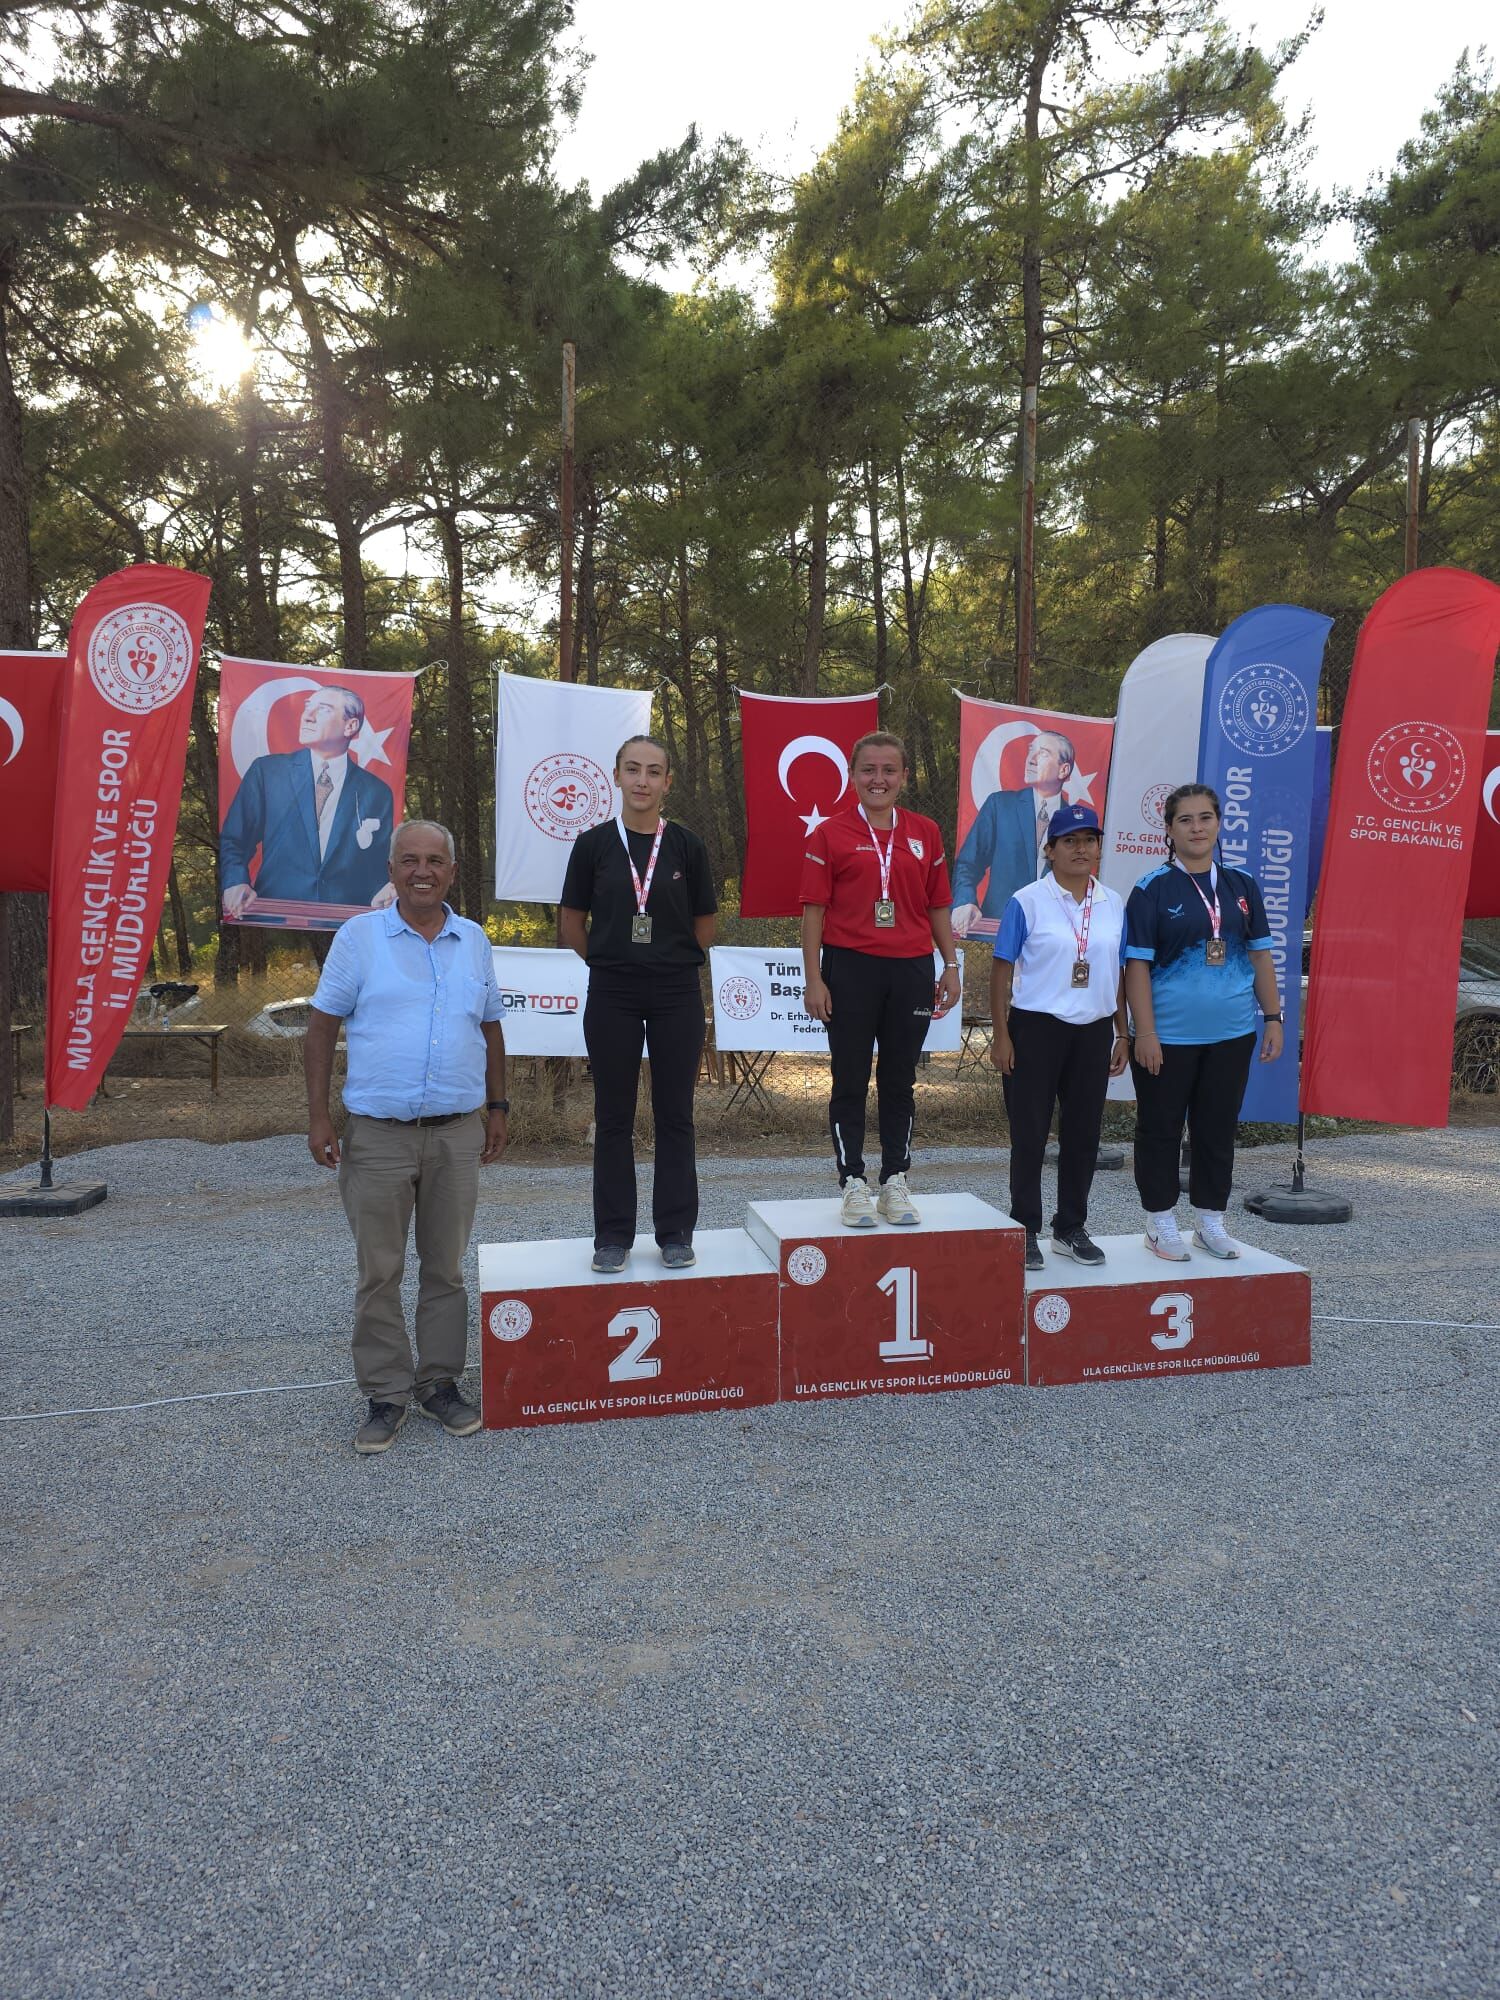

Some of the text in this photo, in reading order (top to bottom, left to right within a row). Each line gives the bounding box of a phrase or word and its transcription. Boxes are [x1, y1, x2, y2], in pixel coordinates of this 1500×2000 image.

[1223, 766, 1252, 832] SPOR
[1117, 831, 1136, 842] T.C.
[1355, 815, 1462, 836] T.C. GENÇLİK VE
[1115, 843, 1143, 854] SPOR
[1349, 828, 1463, 850] SPOR BAKANLIĞI
[66, 729, 131, 1070] MUĞLA GENÇLİK VE SPOR
[102, 799, 158, 1009] İL MÜDÜRLÜĞÜ
[764, 962, 801, 976] Tüm
[770, 1011, 784, 1021] Dr.
[876, 1266, 934, 1363] 1
[1150, 1292, 1194, 1351] 3
[607, 1305, 661, 1382] 2
[1083, 1351, 1260, 1376] ULA GENÇLİK VE SPOR İLÇE MÜDÜRLÜĞÜ
[795, 1368, 1011, 1394] ULA GENÇLİK VE SPOR İLÇE MÜDÜRLÜĞÜ
[522, 1386, 744, 1415] ULA GENÇLİK VE SPOR İLÇE MÜDÜRLÜĞÜ
